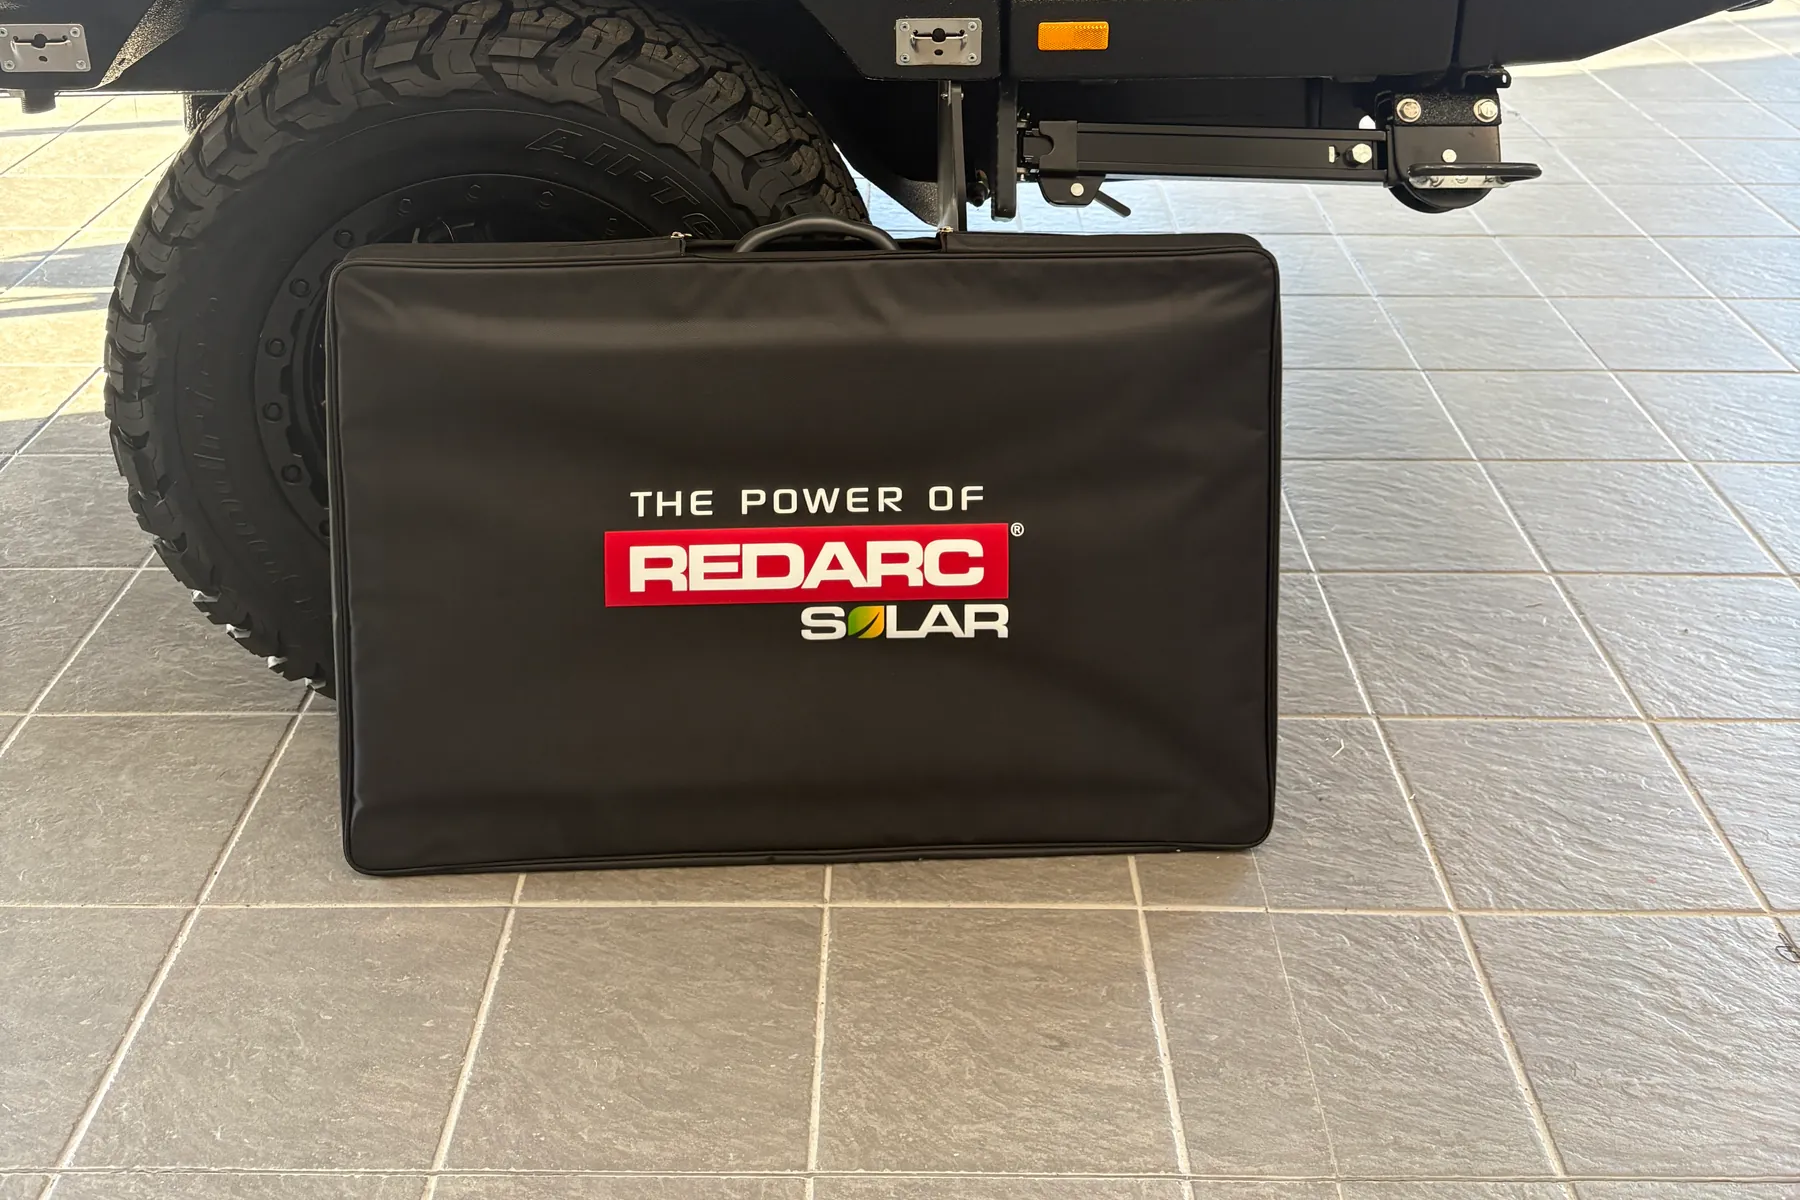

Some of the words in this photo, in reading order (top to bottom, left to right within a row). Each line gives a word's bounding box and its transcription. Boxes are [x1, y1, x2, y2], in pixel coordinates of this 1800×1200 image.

[629, 489, 714, 518] THE
[740, 486, 903, 515] POWER
[928, 484, 985, 512] OF
[628, 538, 985, 593] REDARC
